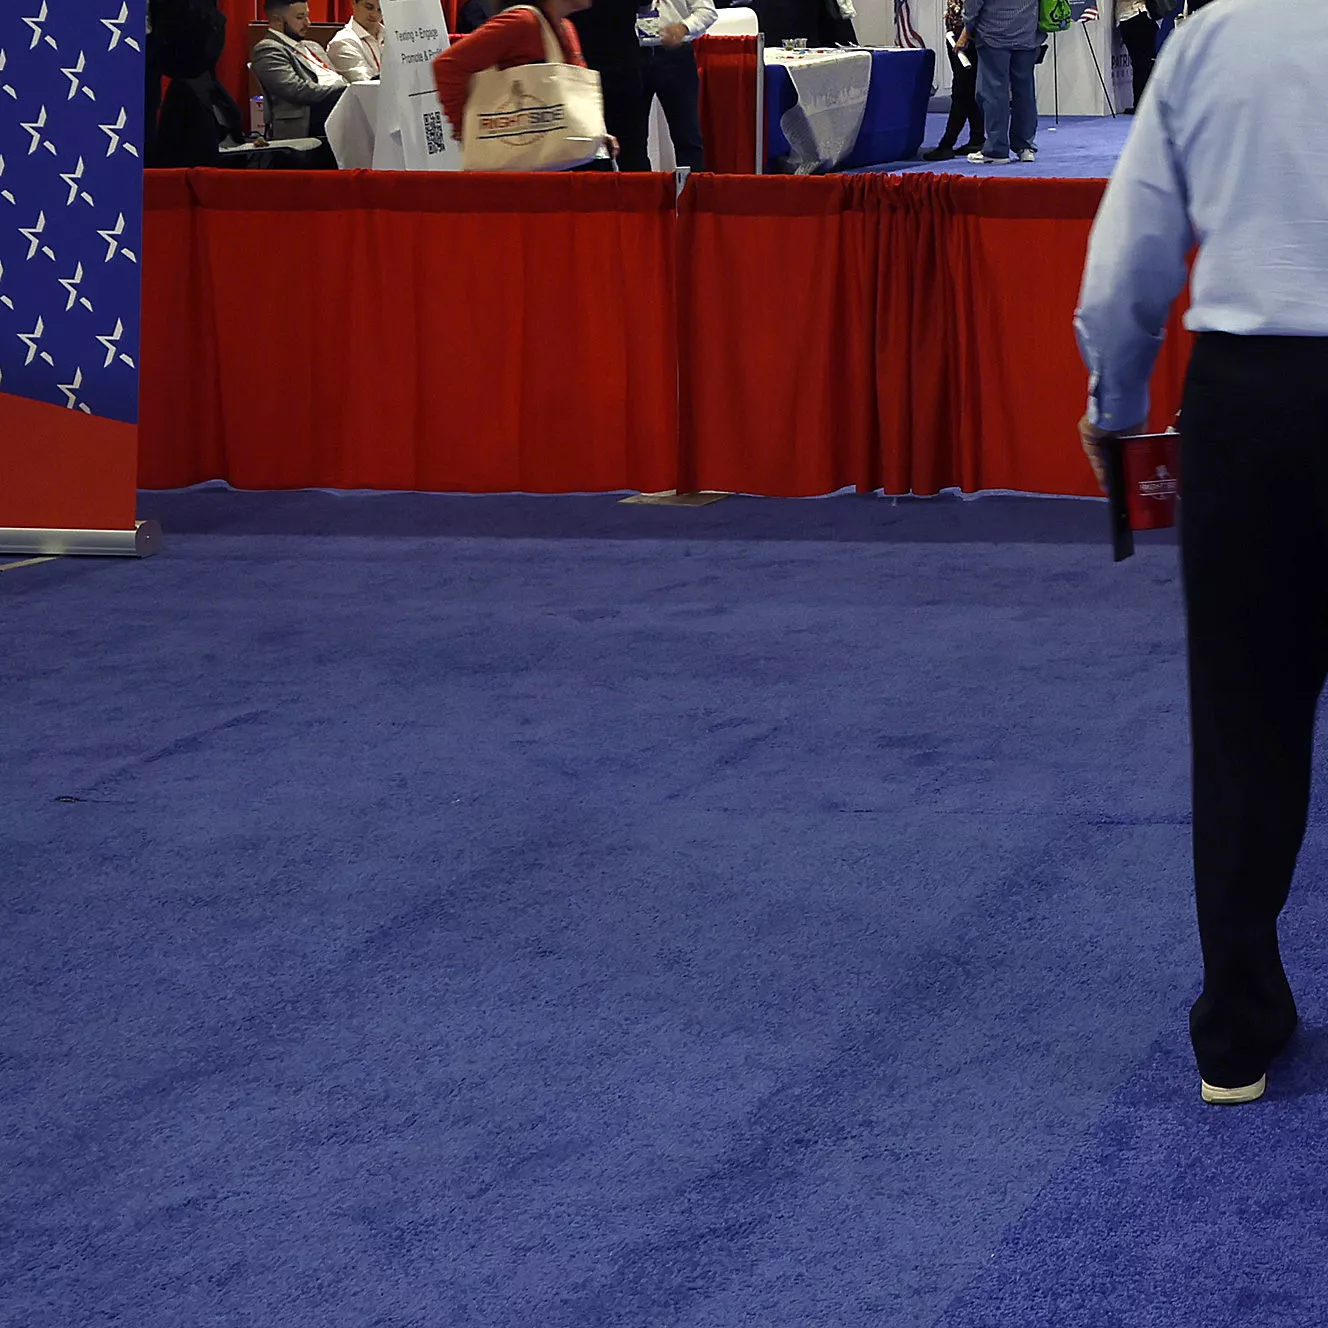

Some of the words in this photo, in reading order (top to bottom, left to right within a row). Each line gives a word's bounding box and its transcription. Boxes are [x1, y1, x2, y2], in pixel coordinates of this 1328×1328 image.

[395, 29, 415, 43] Texting
[419, 27, 439, 41] Engage
[401, 52, 423, 64] Promote
